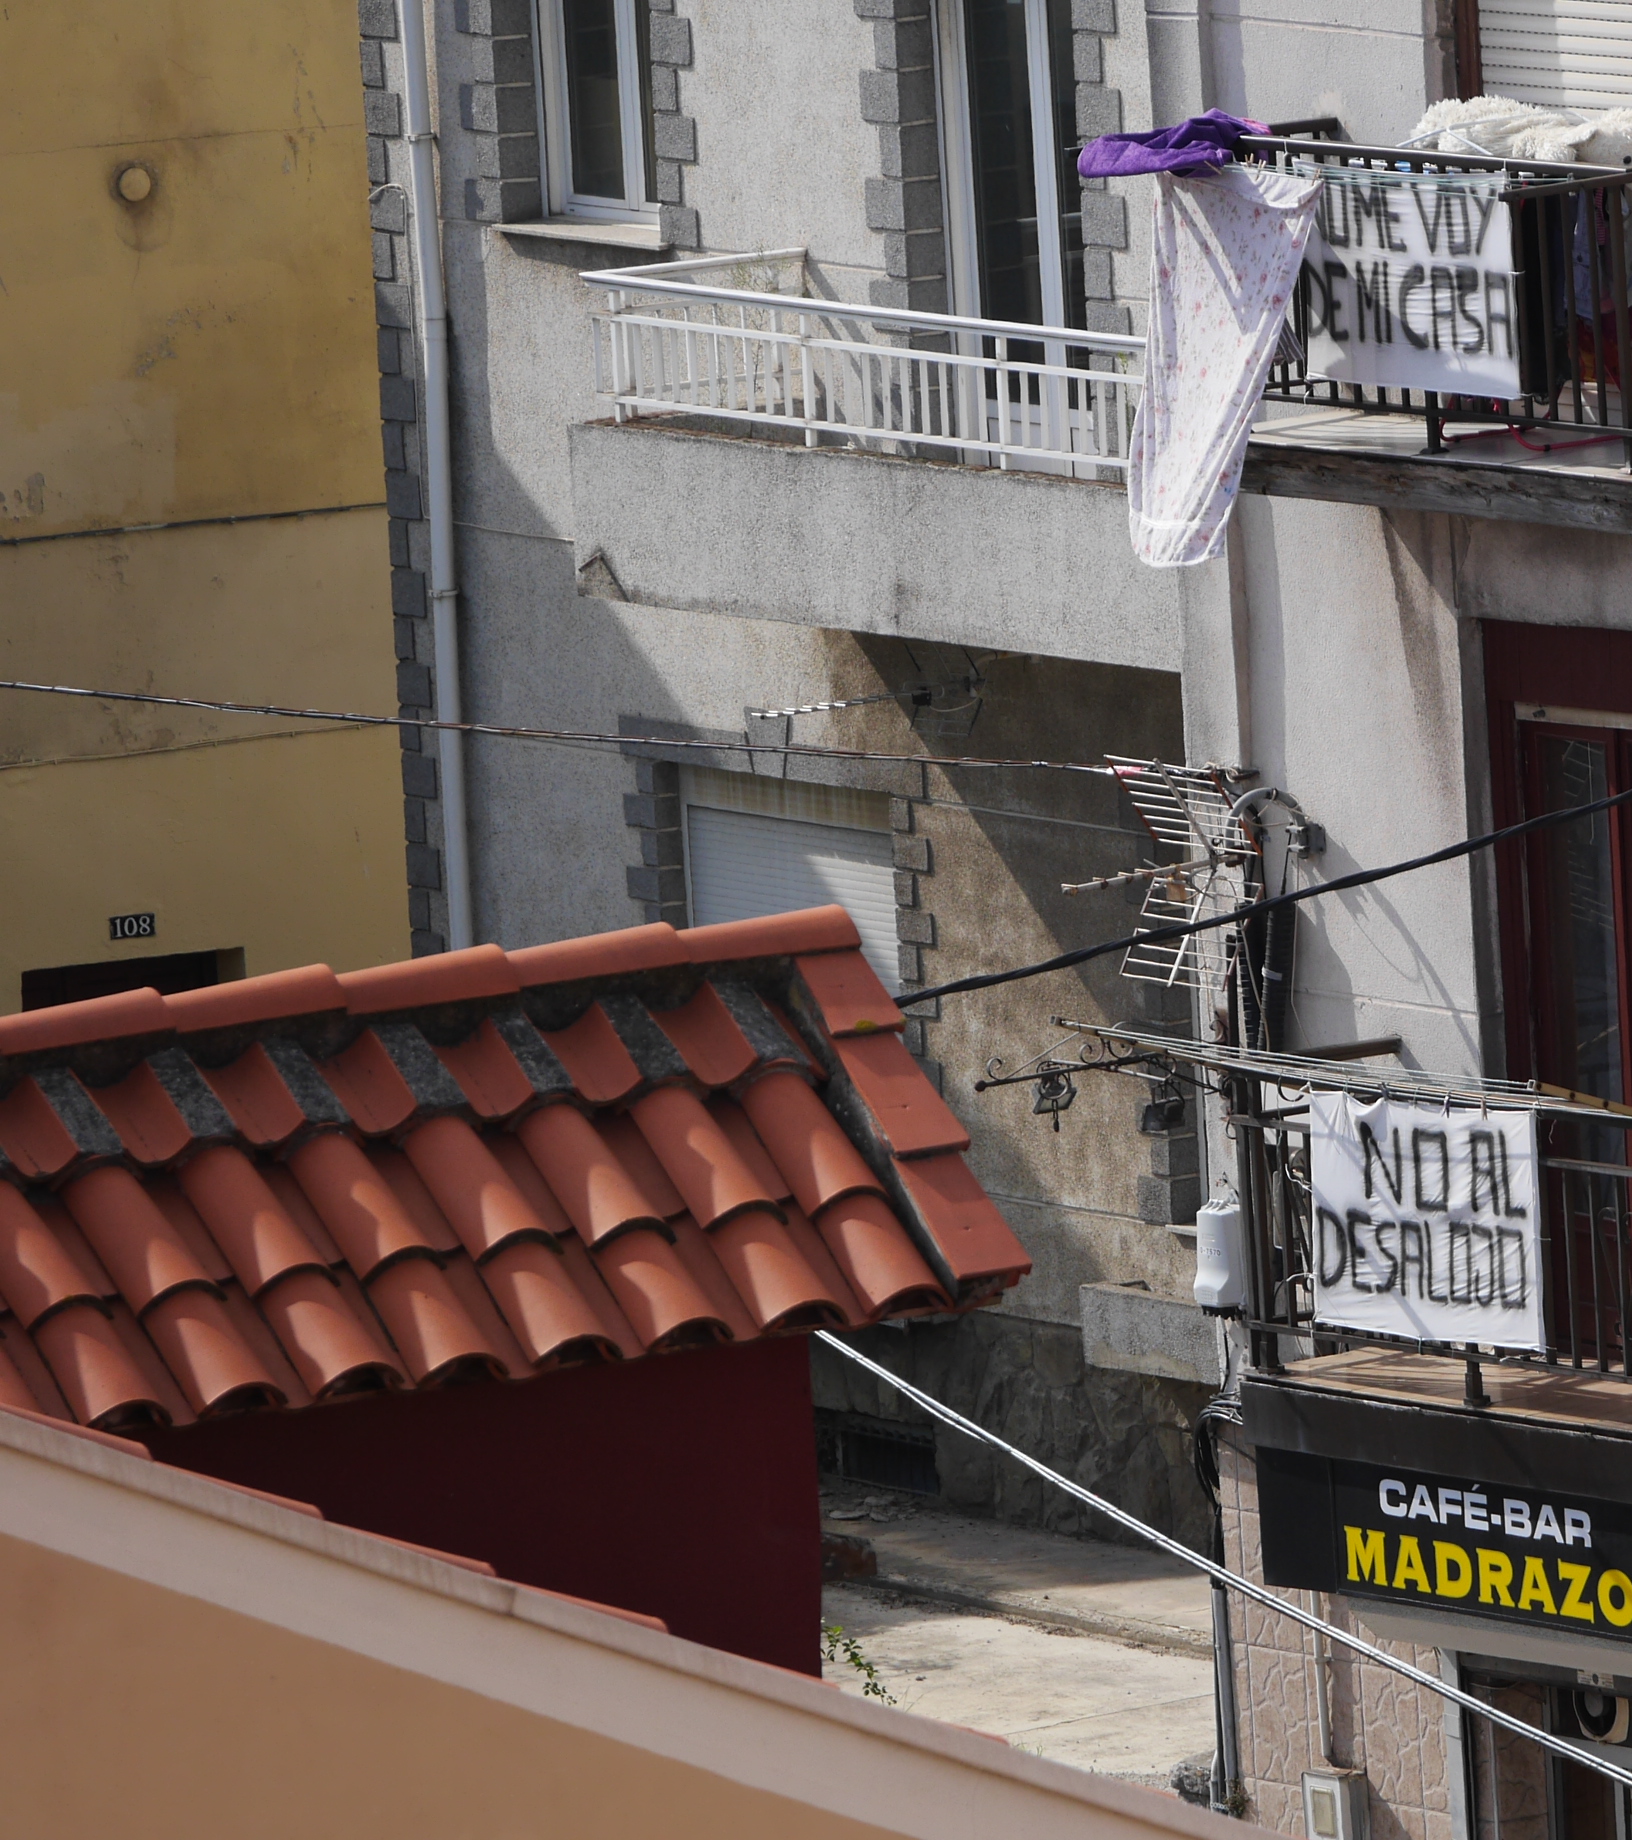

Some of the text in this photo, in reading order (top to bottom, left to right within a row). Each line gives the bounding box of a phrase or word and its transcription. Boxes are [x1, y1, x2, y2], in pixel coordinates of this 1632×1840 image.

[1351, 174, 1408, 253] ME
[1408, 178, 1497, 255] VOY
[1302, 257, 1513, 359] DE MI CASA
[114, 915, 151, 938] 108
[1359, 1120, 1527, 1218] NO AL
[1316, 1205, 1527, 1310] DESALOJO
[1378, 1478, 1592, 1548] CAFÉ-BAR
